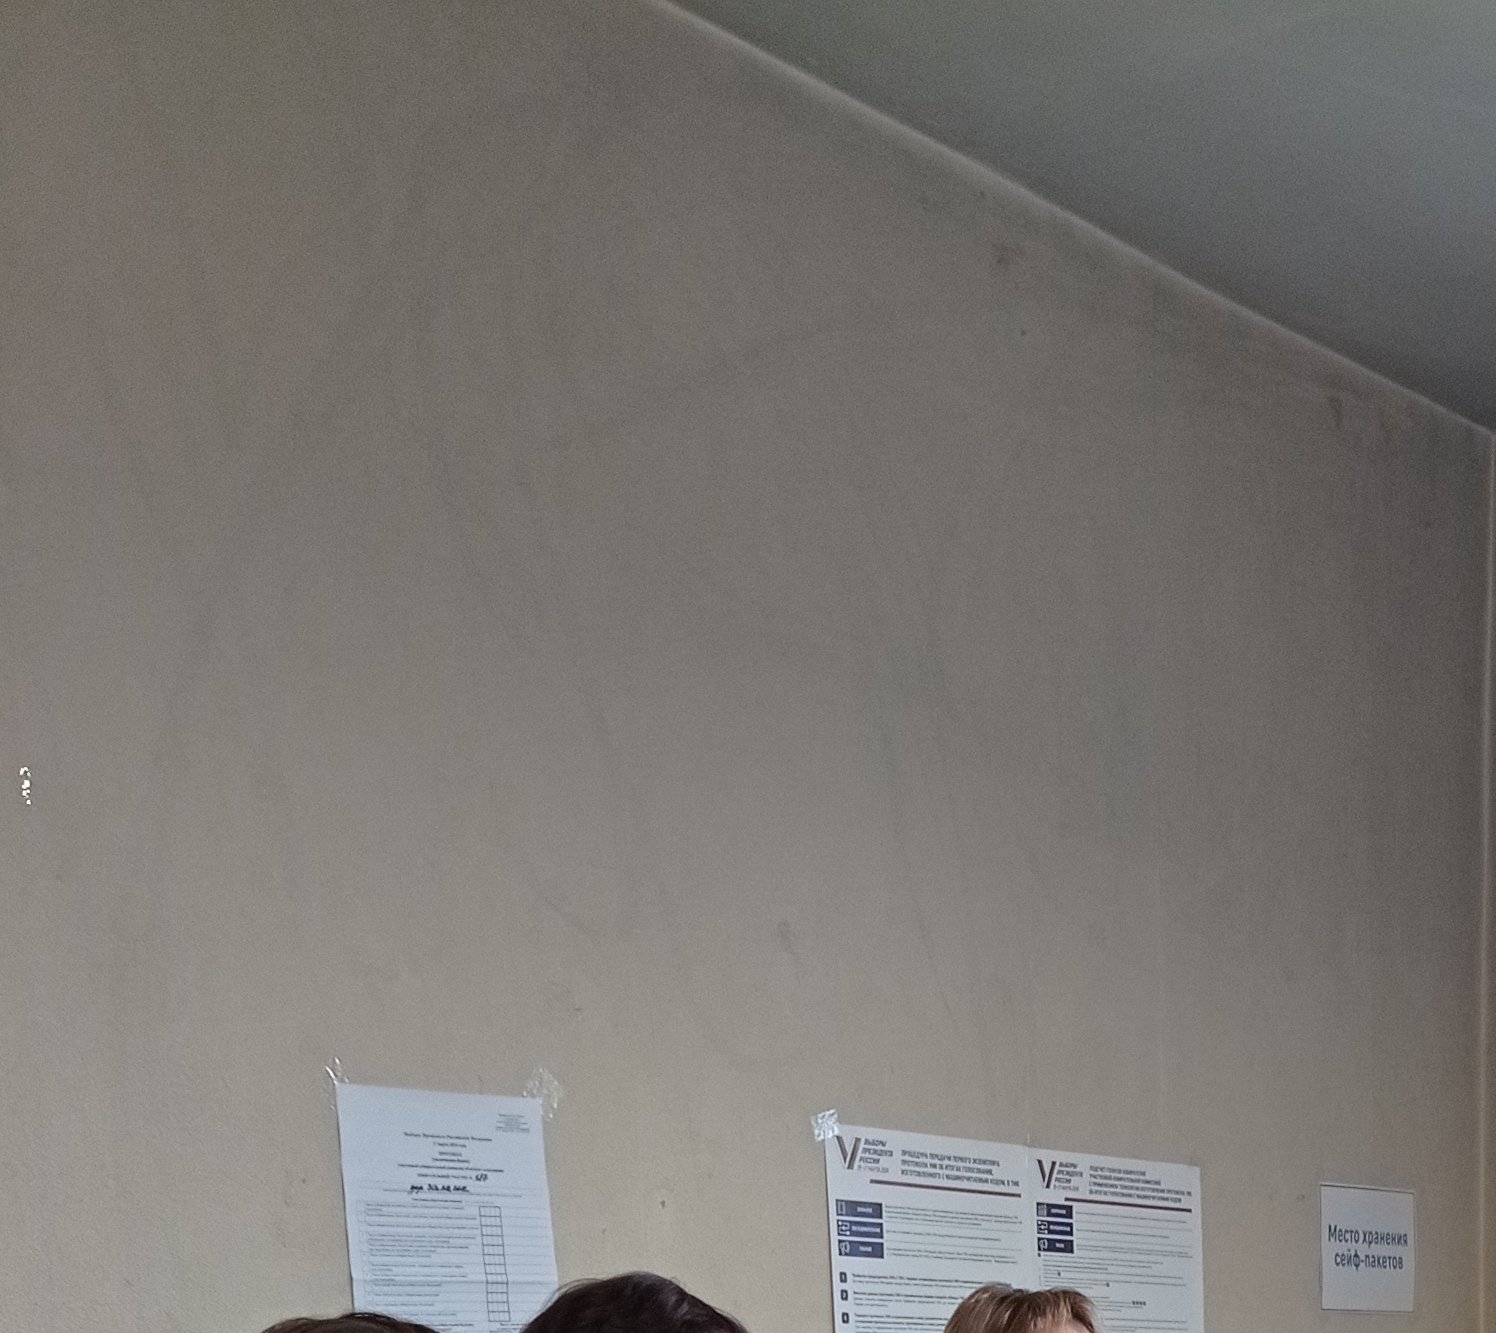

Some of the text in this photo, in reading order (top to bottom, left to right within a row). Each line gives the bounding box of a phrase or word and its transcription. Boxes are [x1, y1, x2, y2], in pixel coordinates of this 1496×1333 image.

[1328, 1224, 1408, 1249] Место хранения
[1334, 1248, 1404, 1271] сейф-пакетов
